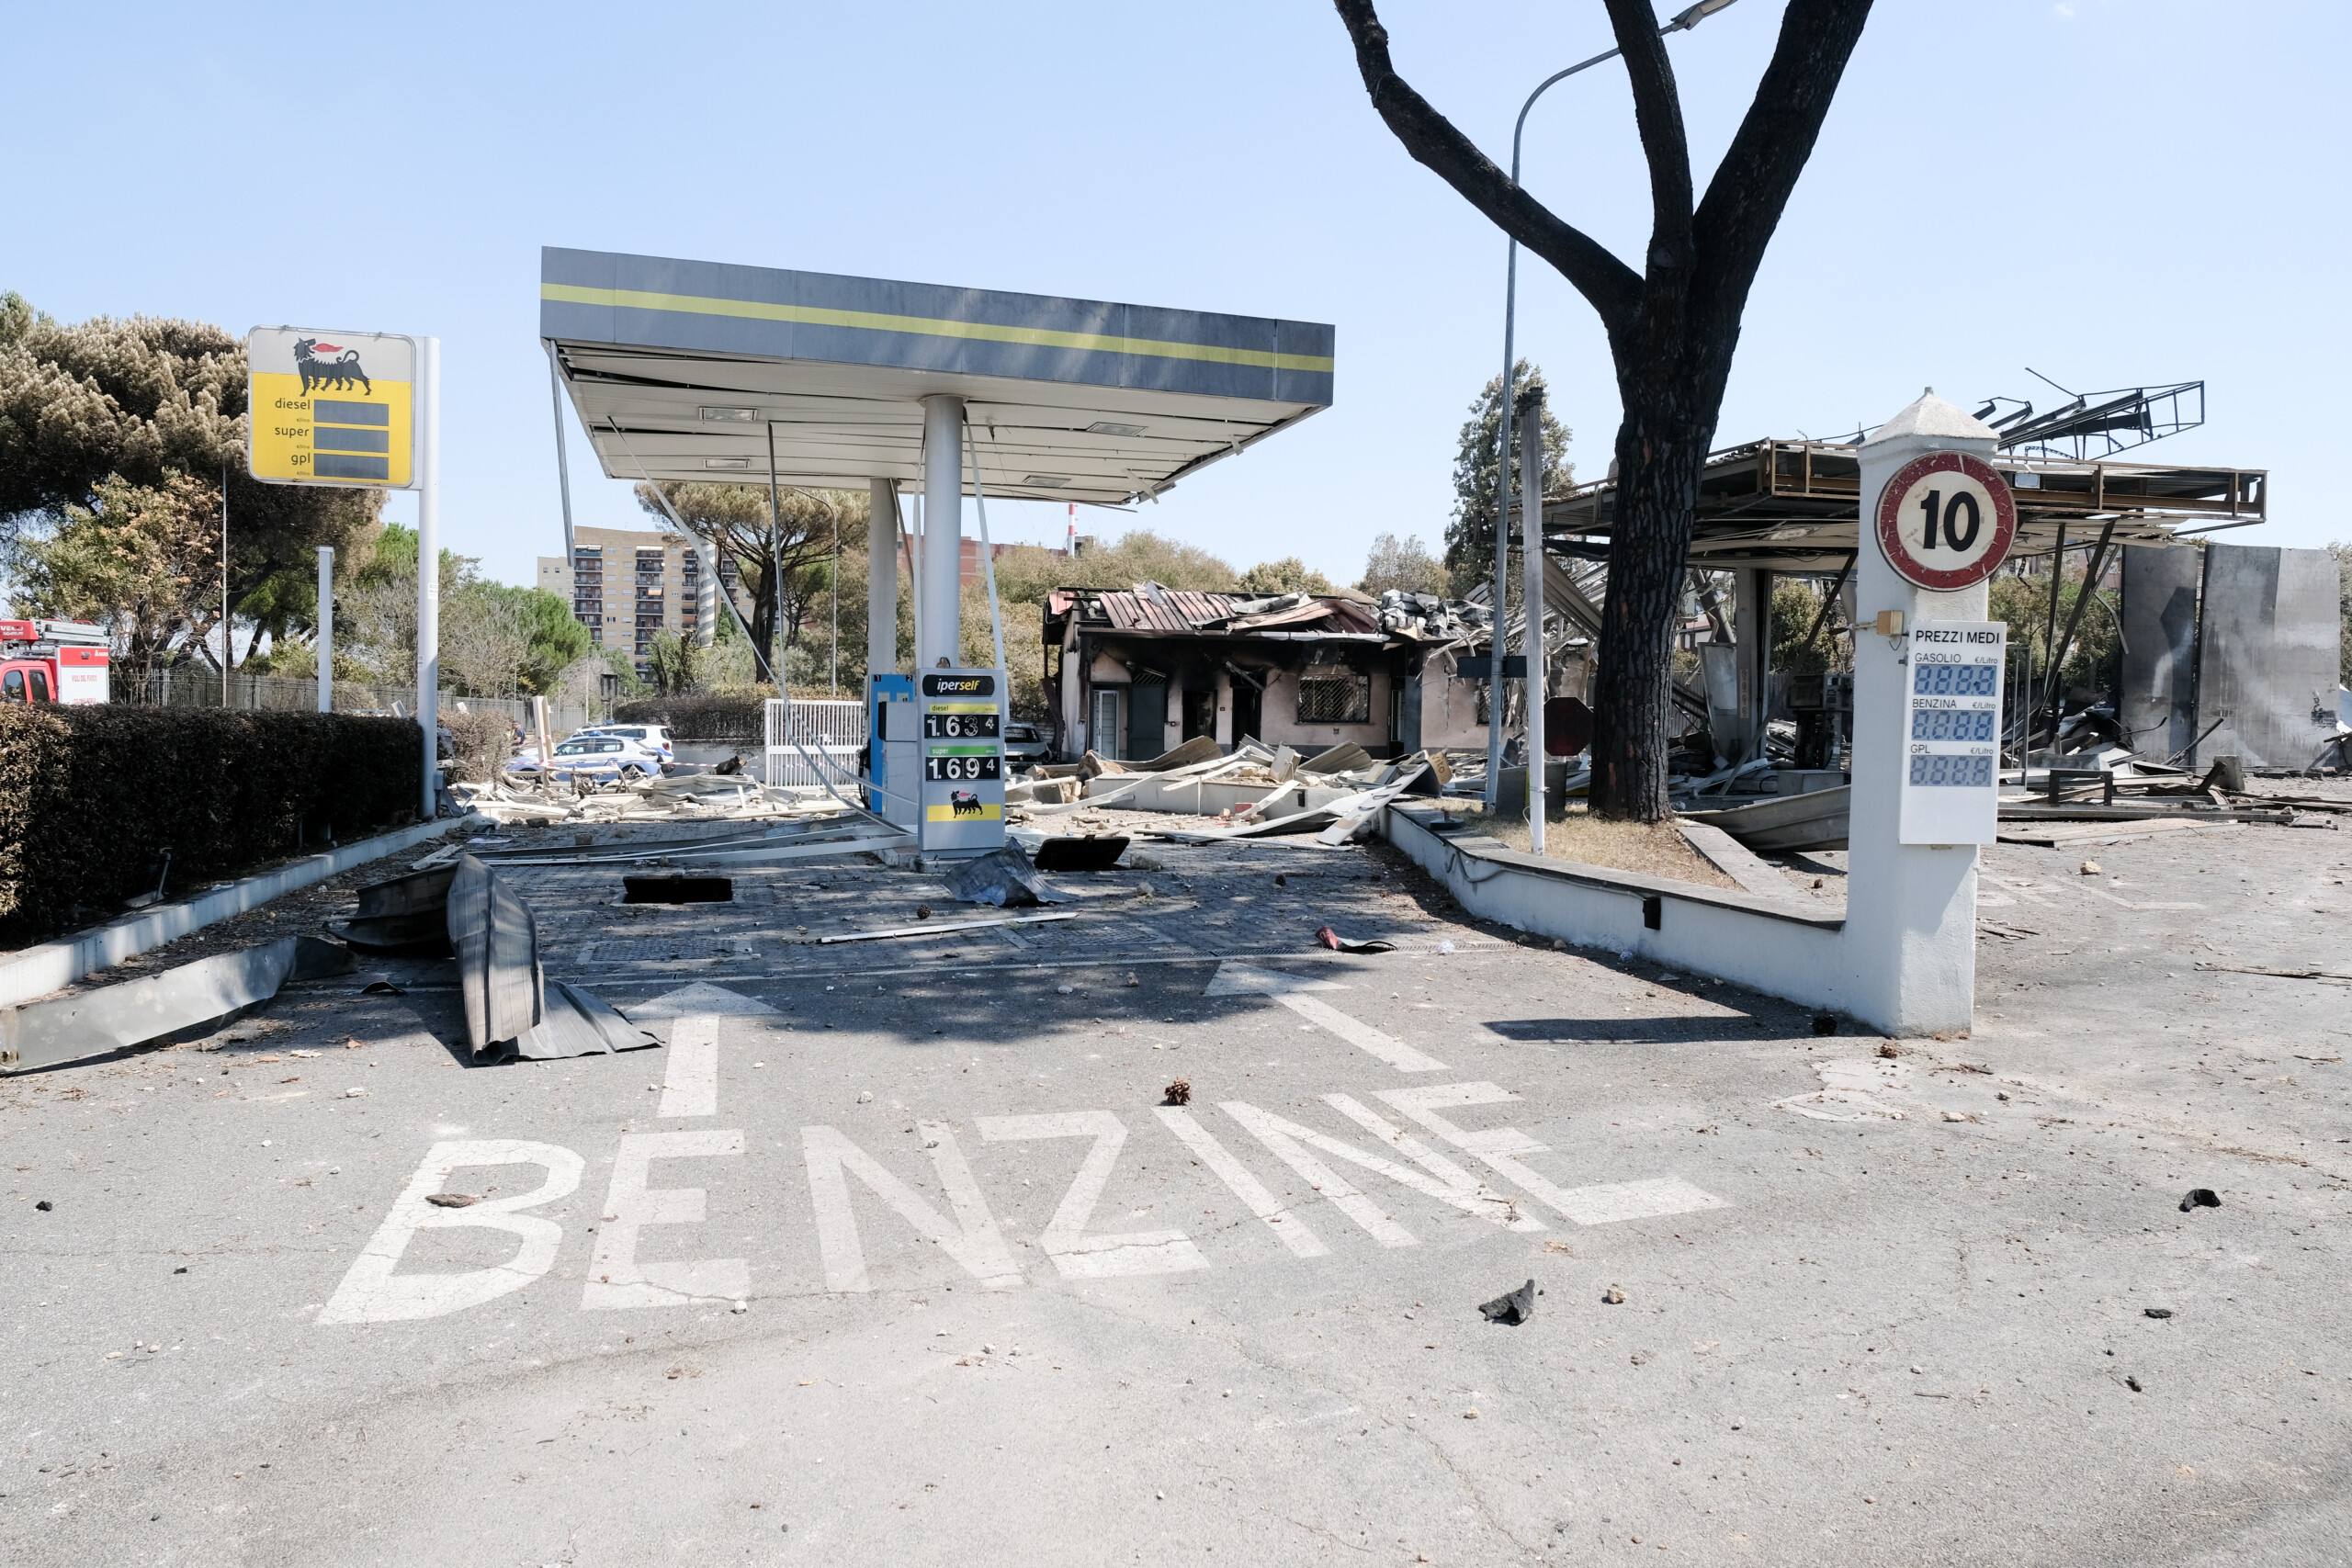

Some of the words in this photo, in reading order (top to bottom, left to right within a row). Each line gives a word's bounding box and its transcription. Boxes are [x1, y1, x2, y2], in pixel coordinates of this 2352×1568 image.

[275, 397, 311, 410] diesel
[275, 427, 310, 438] super
[290, 452, 311, 466] gpl
[1920, 490, 1980, 552] 10
[1916, 630, 1963, 643] PREZZI
[1966, 631, 2000, 644] MEDI
[1915, 652, 1962, 663] GASOLIO
[1974, 656, 1998, 664] €/Litro
[937, 678, 980, 693] iperself
[1912, 698, 1957, 709] BENZINA
[1972, 701, 1996, 710] €/Litro
[1910, 744, 1931, 754] GPL
[1970, 747, 1994, 755] €/Litro
[315, 1080, 1734, 1326] BENZINE
